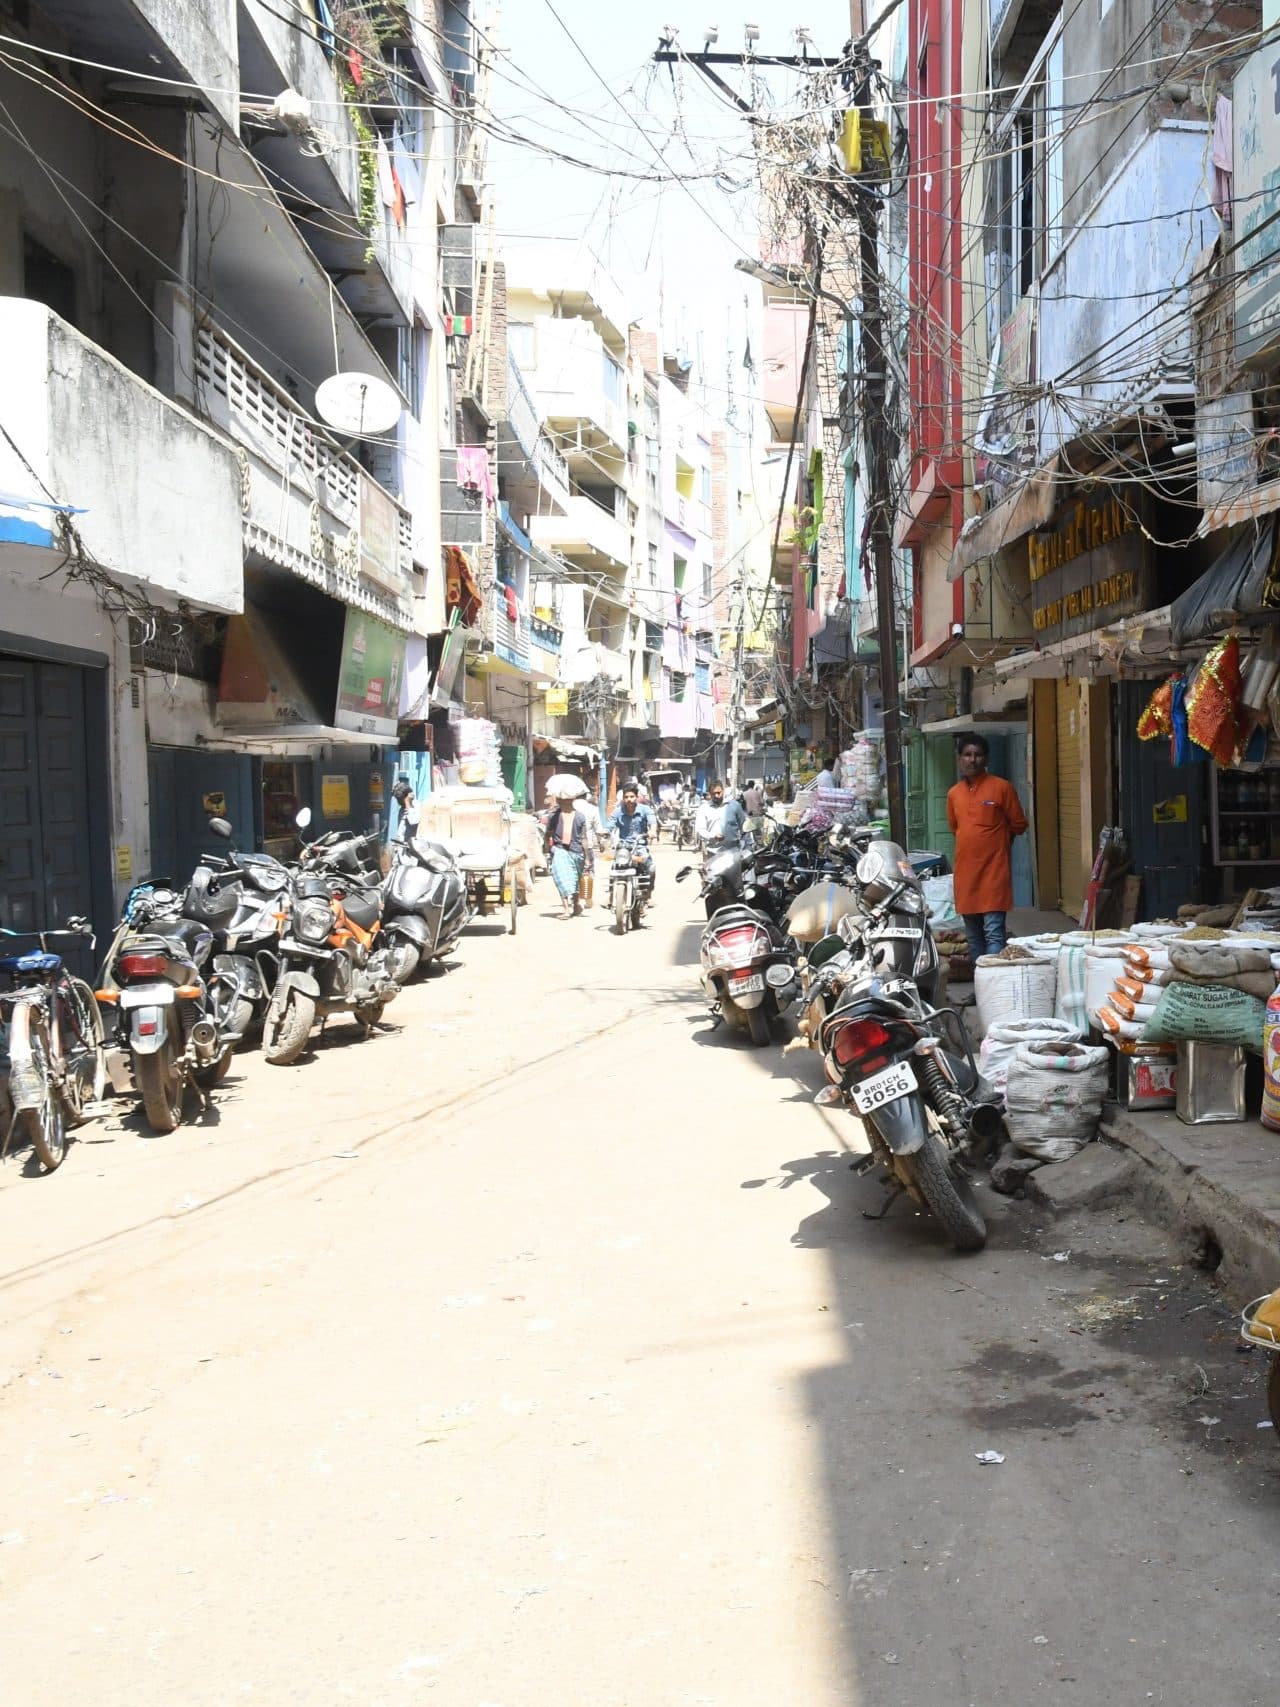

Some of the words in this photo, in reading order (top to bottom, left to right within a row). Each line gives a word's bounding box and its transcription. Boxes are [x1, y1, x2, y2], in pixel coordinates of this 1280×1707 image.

[1202, 992, 1229, 1002] SUGAR
[861, 1078, 910, 1110] 3056
[863, 1073, 901, 1096] BR01CH
